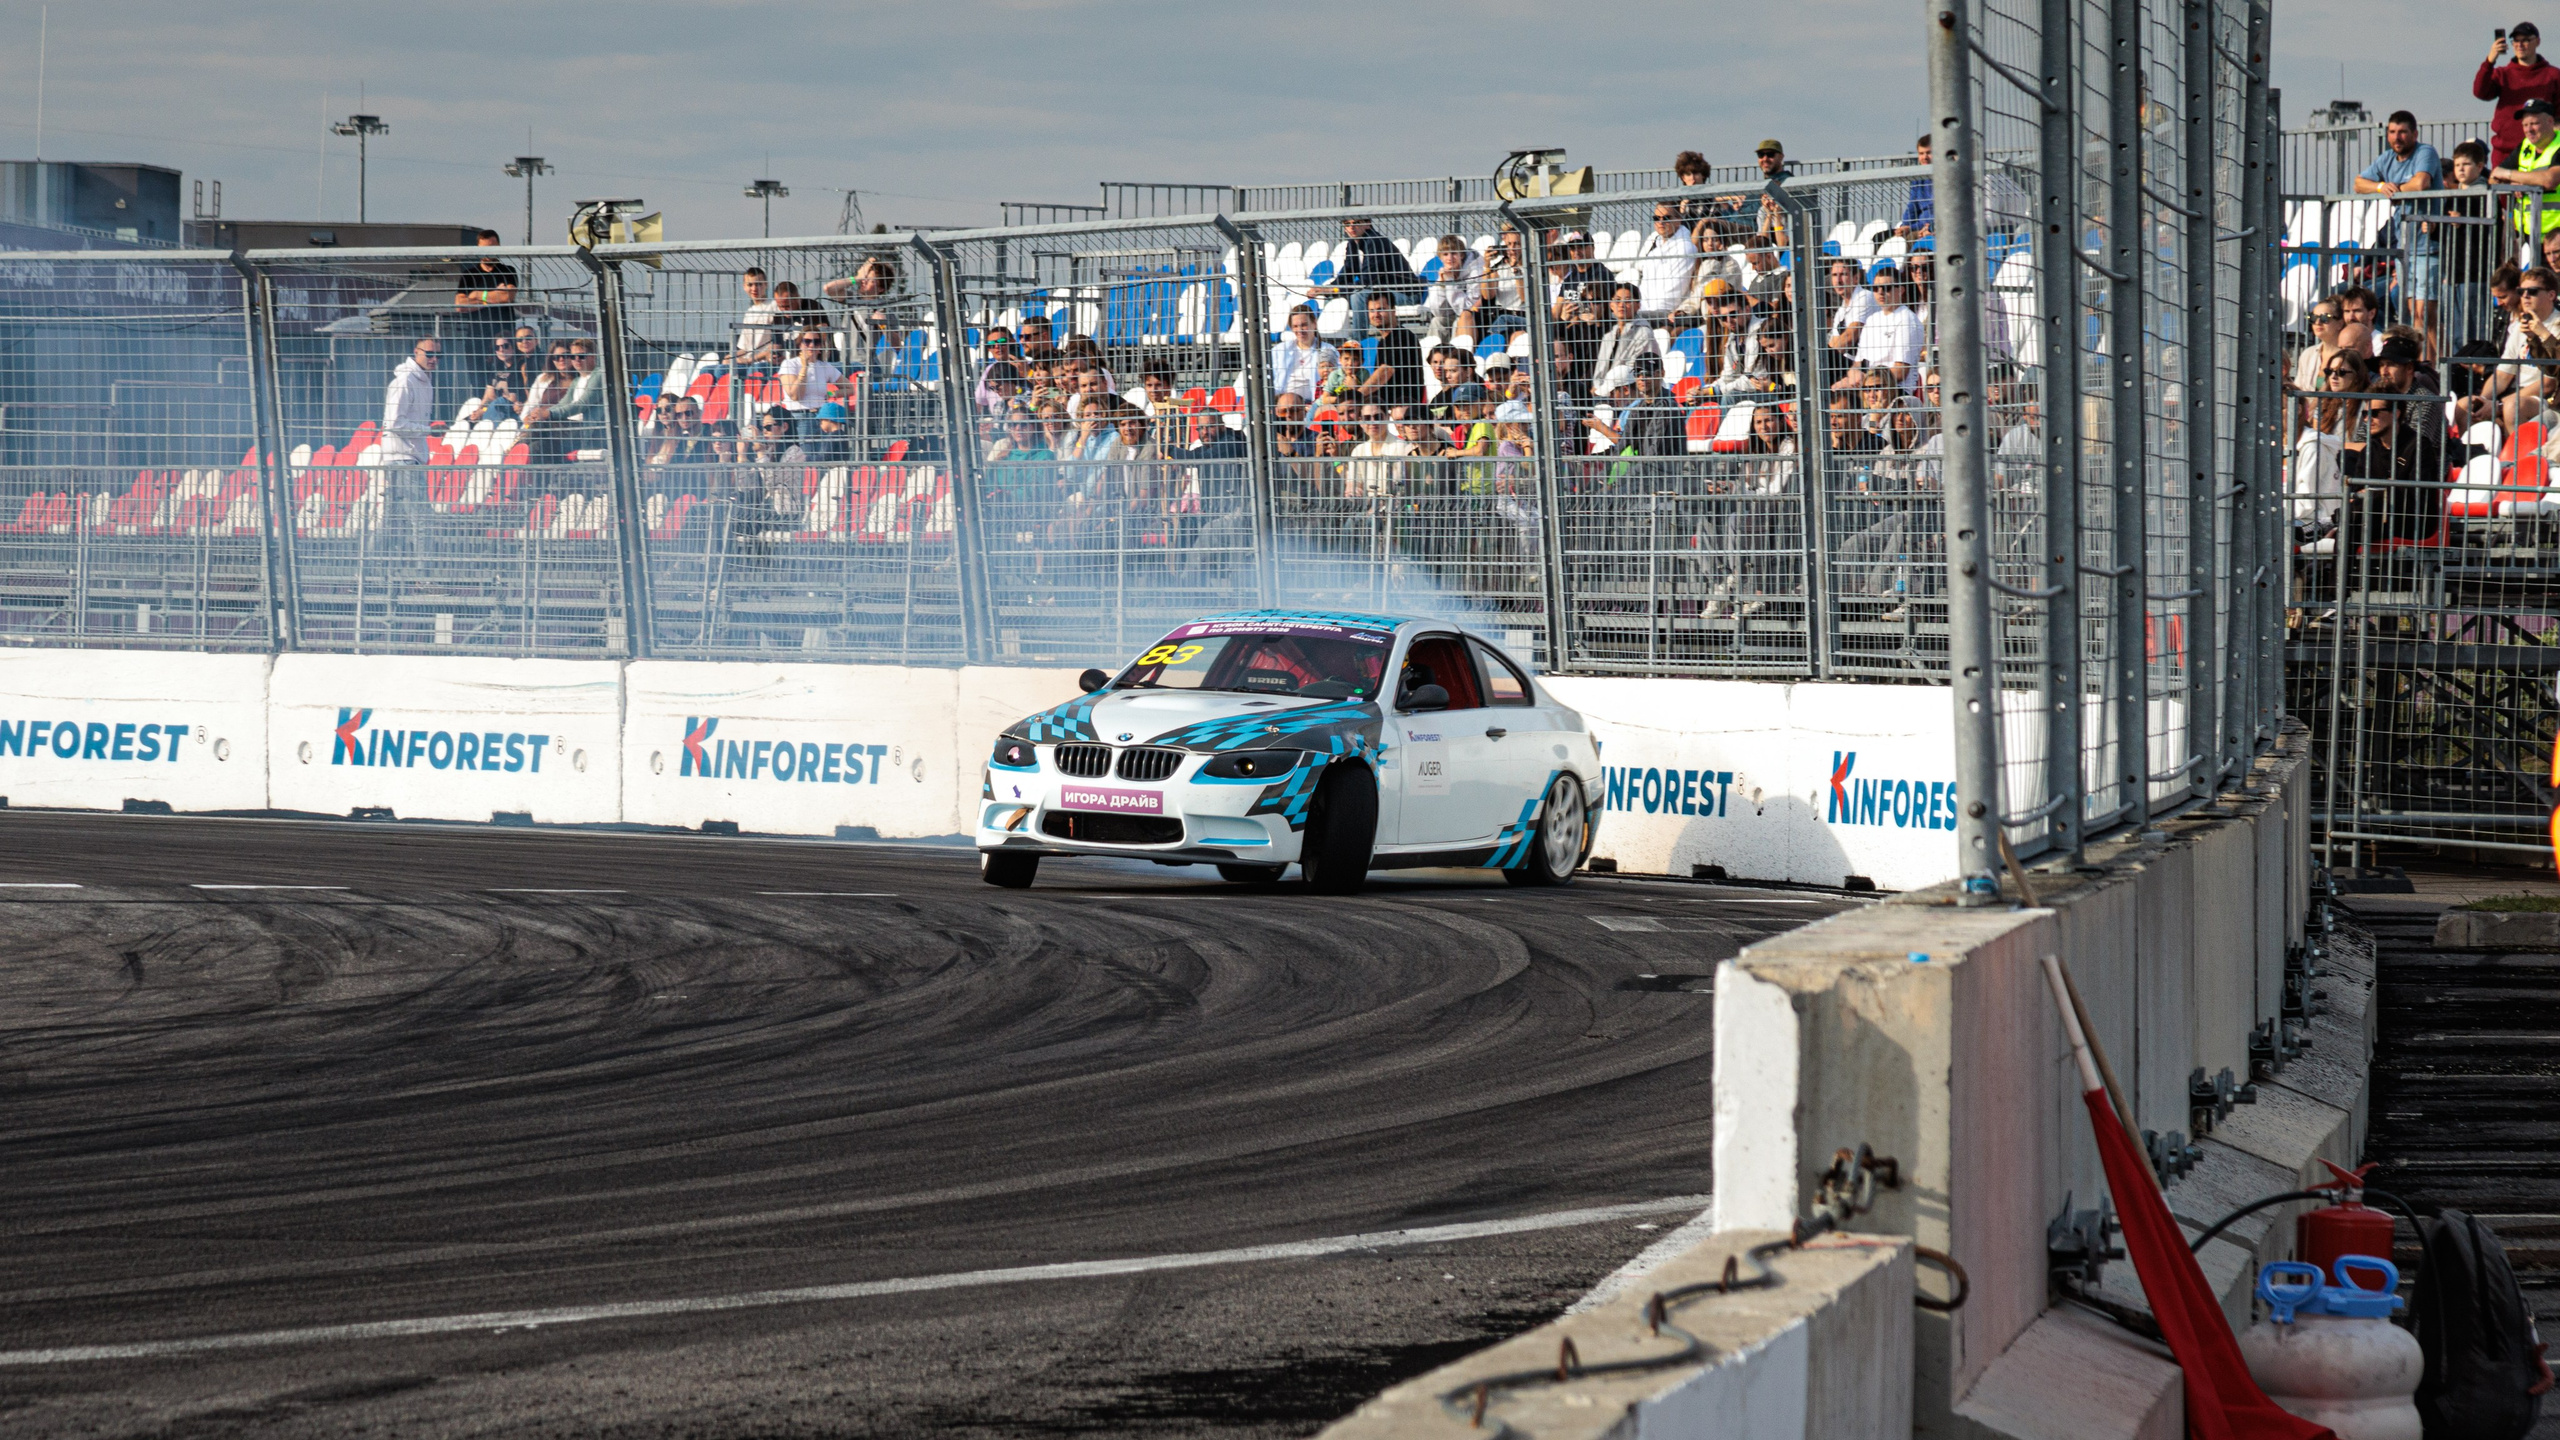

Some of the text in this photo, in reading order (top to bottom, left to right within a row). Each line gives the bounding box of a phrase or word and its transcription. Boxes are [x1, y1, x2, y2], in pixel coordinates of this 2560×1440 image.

[1246, 623, 1342, 632] САНКТ-ПЕТЕРБУРГА
[1137, 644, 1204, 666] 83
[1247, 676, 1287, 685] BRIDE
[1418, 761, 1442, 776] AUGER
[1065, 791, 1159, 808] ИГОРА ДРАЙВ
